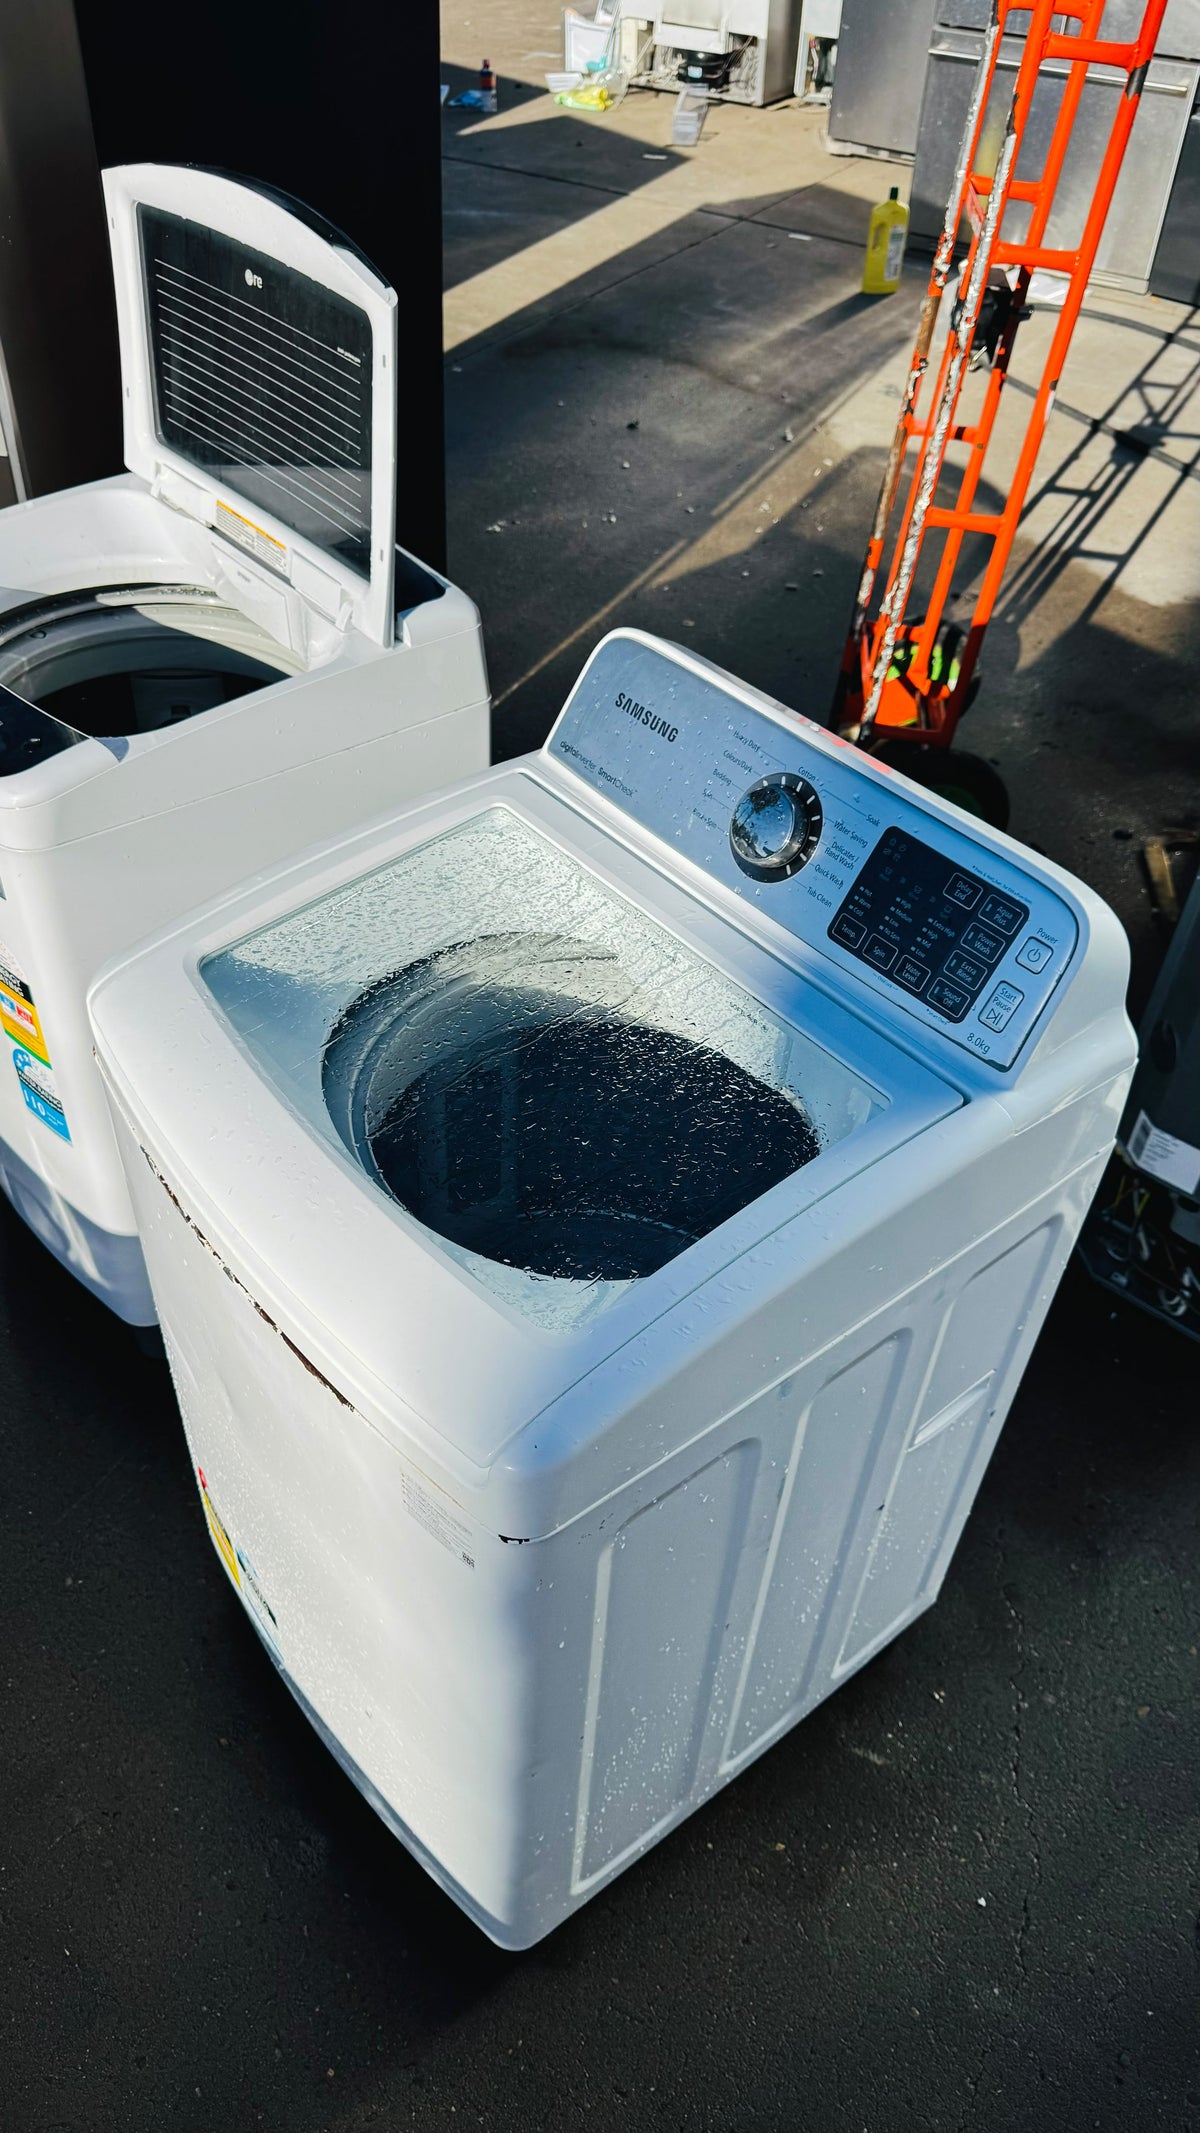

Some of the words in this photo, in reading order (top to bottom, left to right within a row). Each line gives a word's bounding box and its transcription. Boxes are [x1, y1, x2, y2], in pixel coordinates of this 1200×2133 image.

[615, 692, 679, 743] SAMSUNG
[748, 739, 761, 752] Duty
[713, 768, 732, 787] Bedding
[798, 766, 817, 782] Cotton
[866, 814, 881, 828] Soak
[834, 820, 851, 836] Water
[850, 830, 868, 848] Saving
[824, 847, 840, 861] Hand
[838, 856, 854, 871] Wash
[814, 864, 830, 879] Quick
[829, 873, 844, 888] Wash
[954, 889, 966, 901] End
[956, 881, 974, 896] Delay
[807, 886, 818, 898] Tub
[816, 893, 832, 908] Clean
[993, 913, 1007, 926] Plus
[996, 906, 1013, 920] Aqua
[977, 932, 996, 948] Power
[1036, 927, 1059, 945] Power
[873, 946, 886, 958] Spin
[974, 940, 990, 955] Wash
[905, 962, 921, 977] Water
[956, 968, 973, 982] Rinse
[960, 961, 977, 976] Extra
[902, 969, 918, 984] Level
[943, 987, 962, 1003] Sound
[943, 997, 954, 1008] Off
[1000, 987, 1017, 1003] Start
[993, 996, 1012, 1014] Pause
[967, 1033, 991, 1055] 8.0kg
